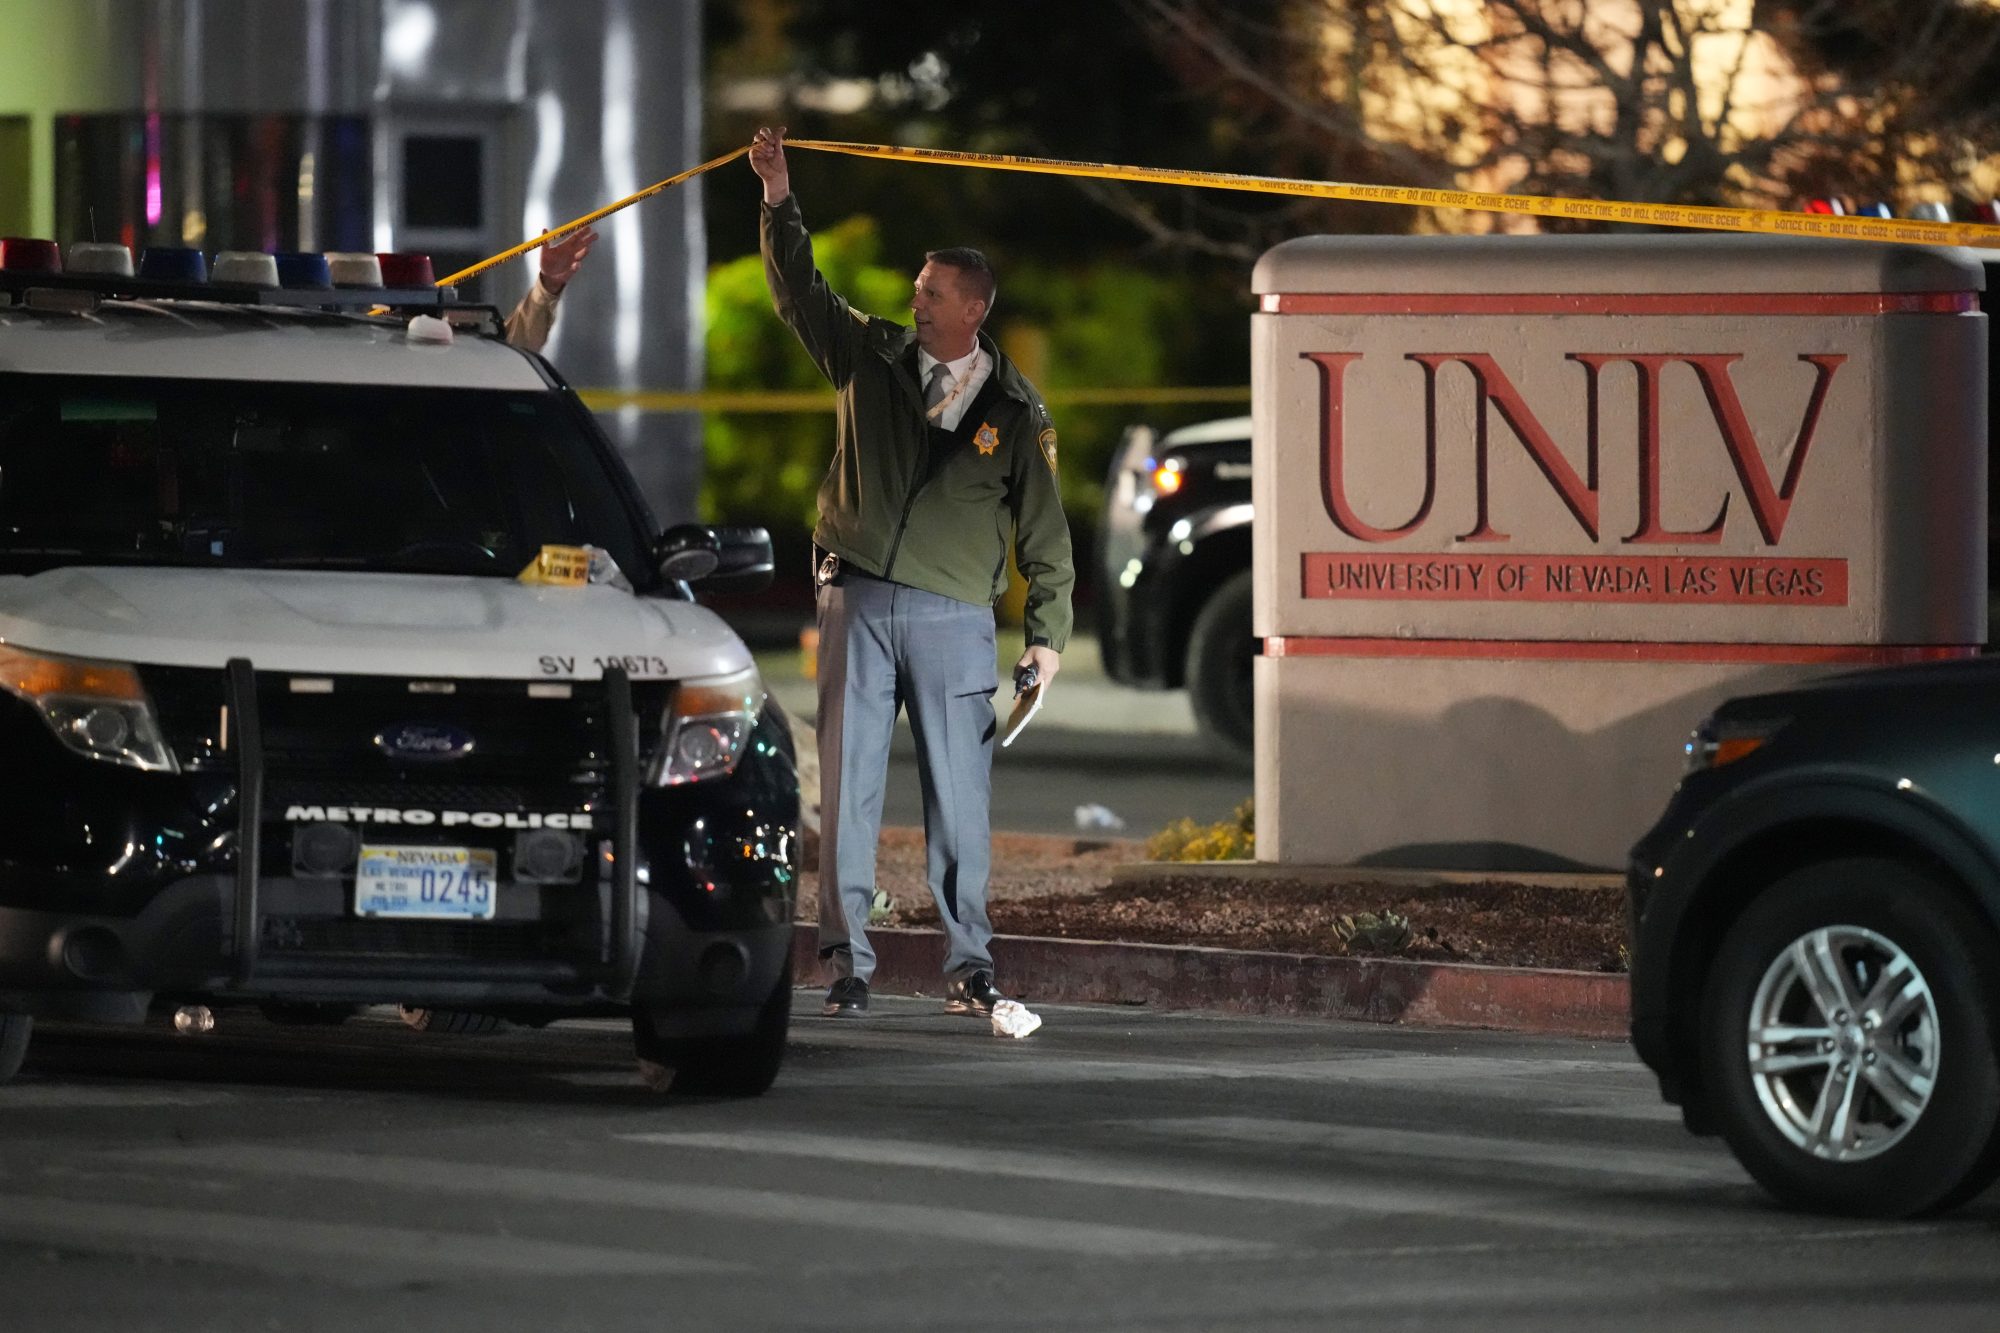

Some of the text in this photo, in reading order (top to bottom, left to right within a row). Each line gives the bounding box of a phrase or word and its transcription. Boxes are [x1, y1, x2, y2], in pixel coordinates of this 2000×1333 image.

[1299, 352, 1849, 546] UNLV
[548, 566, 570, 578] NOT
[1327, 561, 1824, 597] UNIVERSITY OF NEVADA LAS VEGAS
[539, 656, 668, 675] SV 10673
[395, 729, 453, 750] Ford
[285, 805, 593, 829] METRO POLICE
[421, 870, 489, 903] 0245
